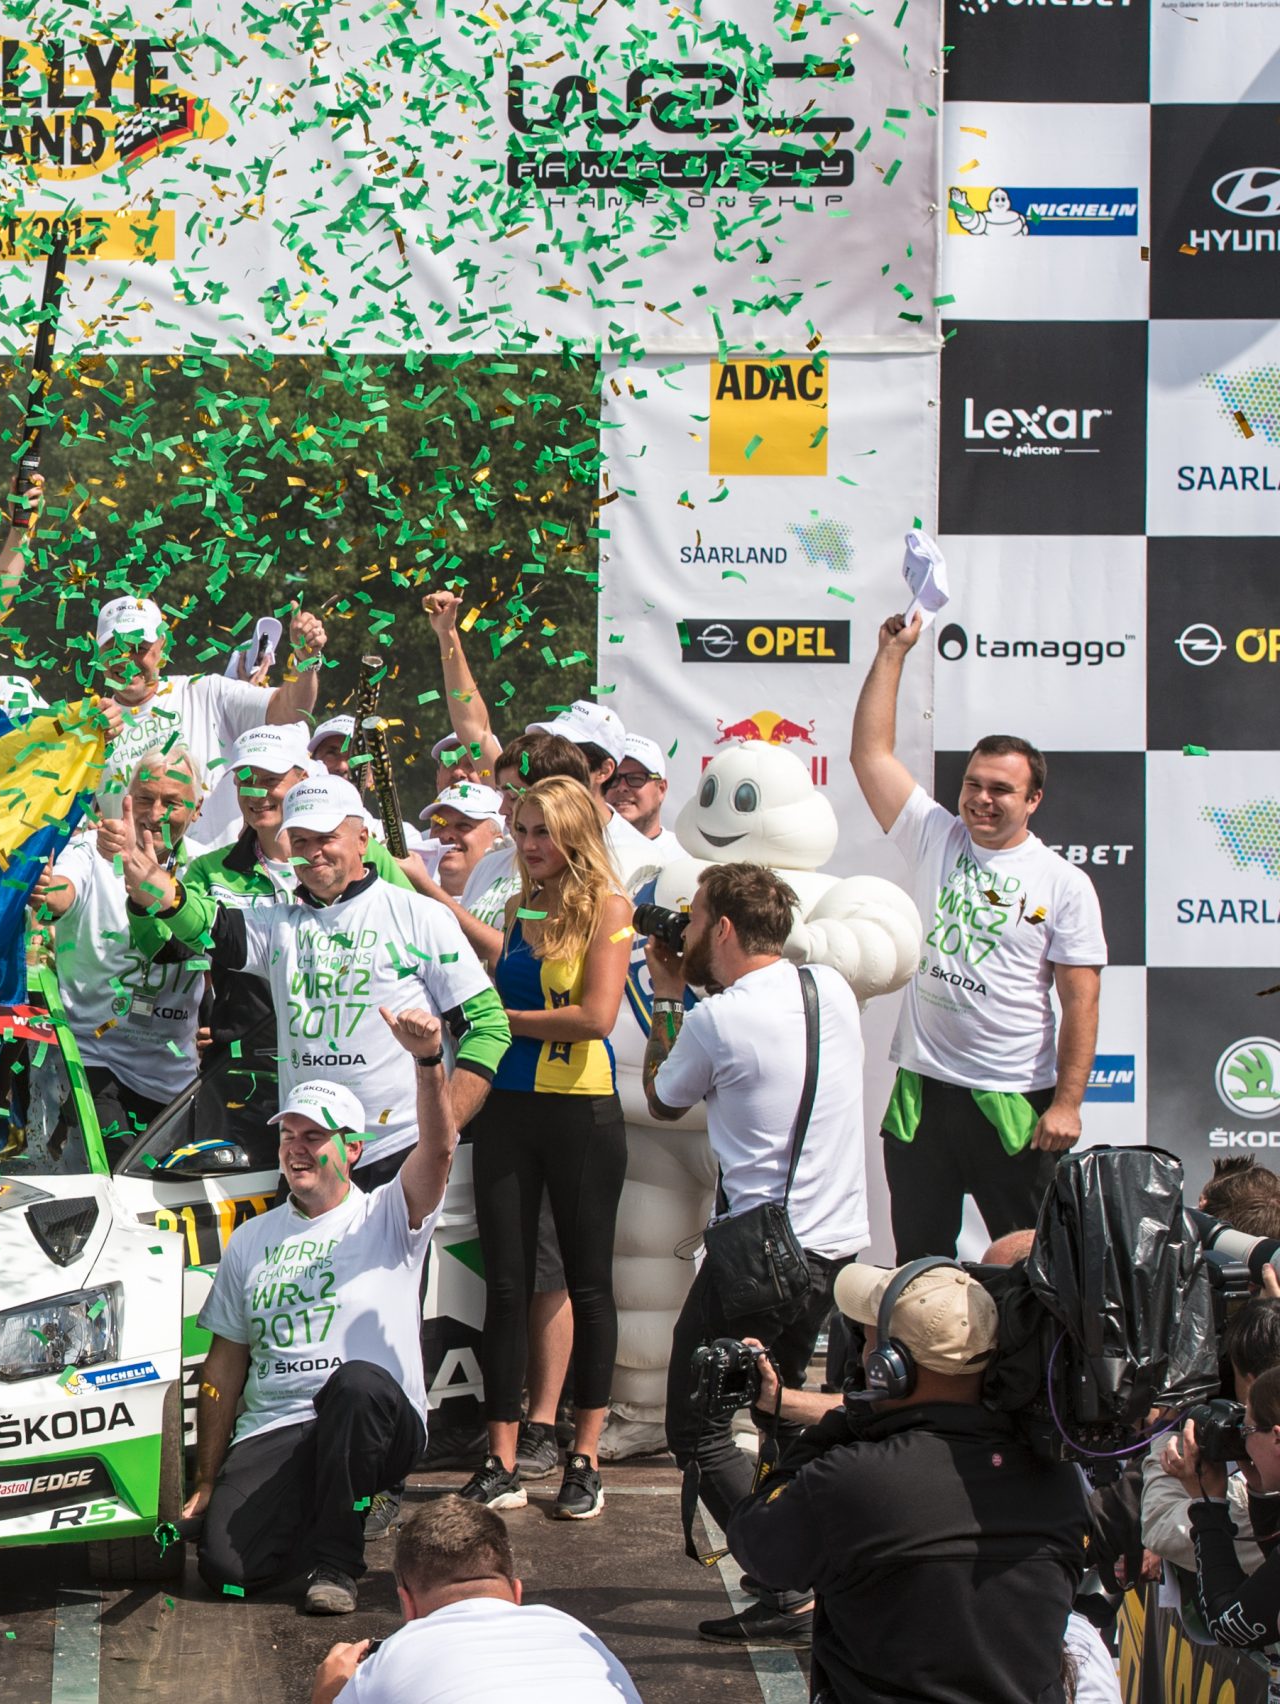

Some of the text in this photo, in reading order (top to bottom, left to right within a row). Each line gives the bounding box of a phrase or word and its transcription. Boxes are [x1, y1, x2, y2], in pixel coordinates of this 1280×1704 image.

[1027, 203, 1137, 217] MICHELIN
[1189, 229, 1280, 252] HYUN
[715, 364, 824, 401] ADAC
[964, 398, 1103, 440] Lexar
[1177, 465, 1280, 491] SAARL
[680, 546, 787, 565] SAARLAND
[746, 626, 836, 657] OPEL
[976, 634, 1126, 665] tamaggo
[938, 885, 1008, 937] WRC2
[1177, 899, 1280, 924] SAARL
[290, 968, 370, 999] WRC2
[930, 965, 987, 996] ŠKODA
[153, 1006, 189, 1021] KODA
[286, 1001, 369, 1039] 2017
[301, 1052, 367, 1067] ŠKODA
[95, 1365, 156, 1385] MICHELIN
[274, 1357, 343, 1375] ŠKODA
[31, 1468, 96, 1494] EDGE
[49, 1500, 121, 1530] R5
